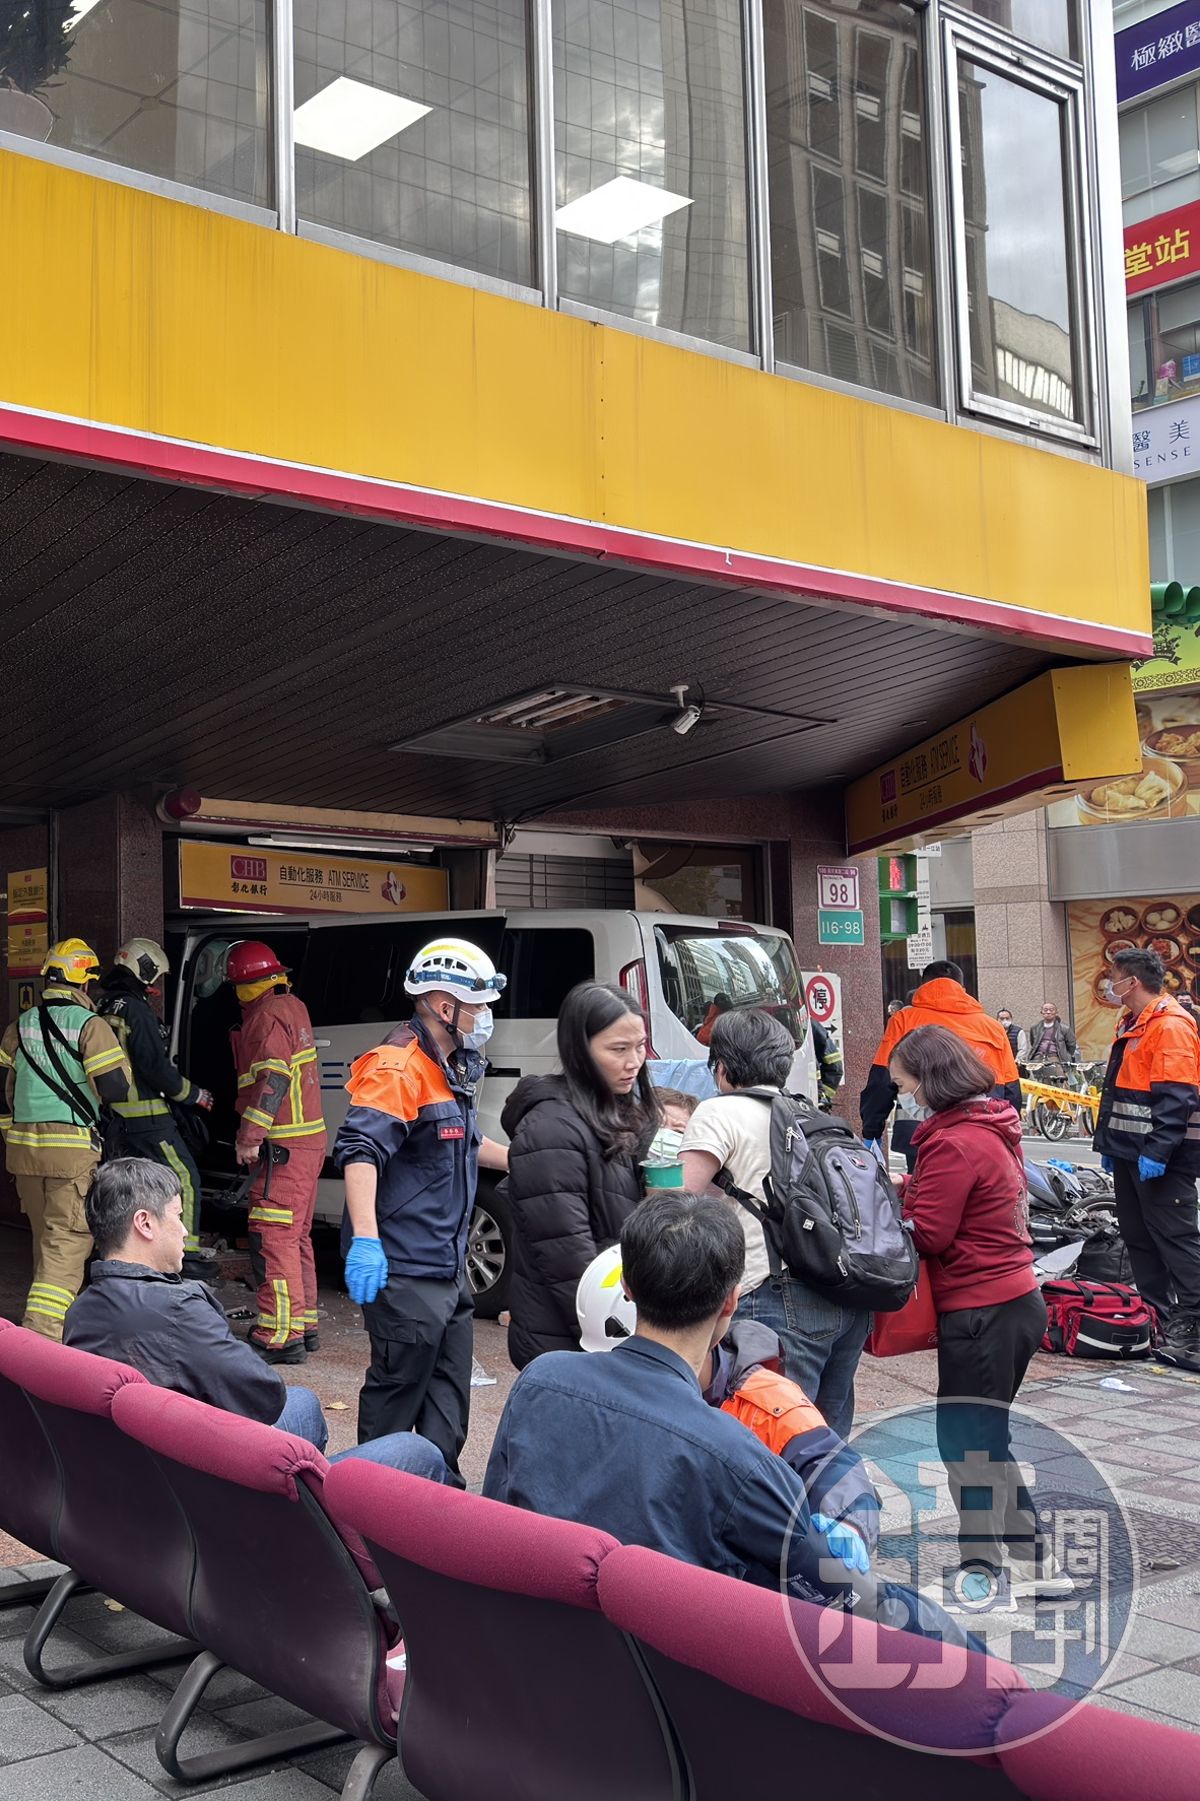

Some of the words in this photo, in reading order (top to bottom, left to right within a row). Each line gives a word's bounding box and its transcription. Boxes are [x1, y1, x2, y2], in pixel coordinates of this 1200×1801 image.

[1124, 228, 1190, 279] 堂站
[1133, 420, 1190, 452] 醫美
[1134, 446, 1191, 469] SENSE
[232, 857, 266, 880] CHB
[280, 865, 323, 884] 自動化服務
[328, 869, 341, 886] ATM
[341, 871, 369, 889] SERVICE
[231, 882, 268, 896] 彰化銀行
[829, 883, 849, 903] 98
[821, 921, 861, 935] 116-98
[813, 989, 828, 1009] 停
